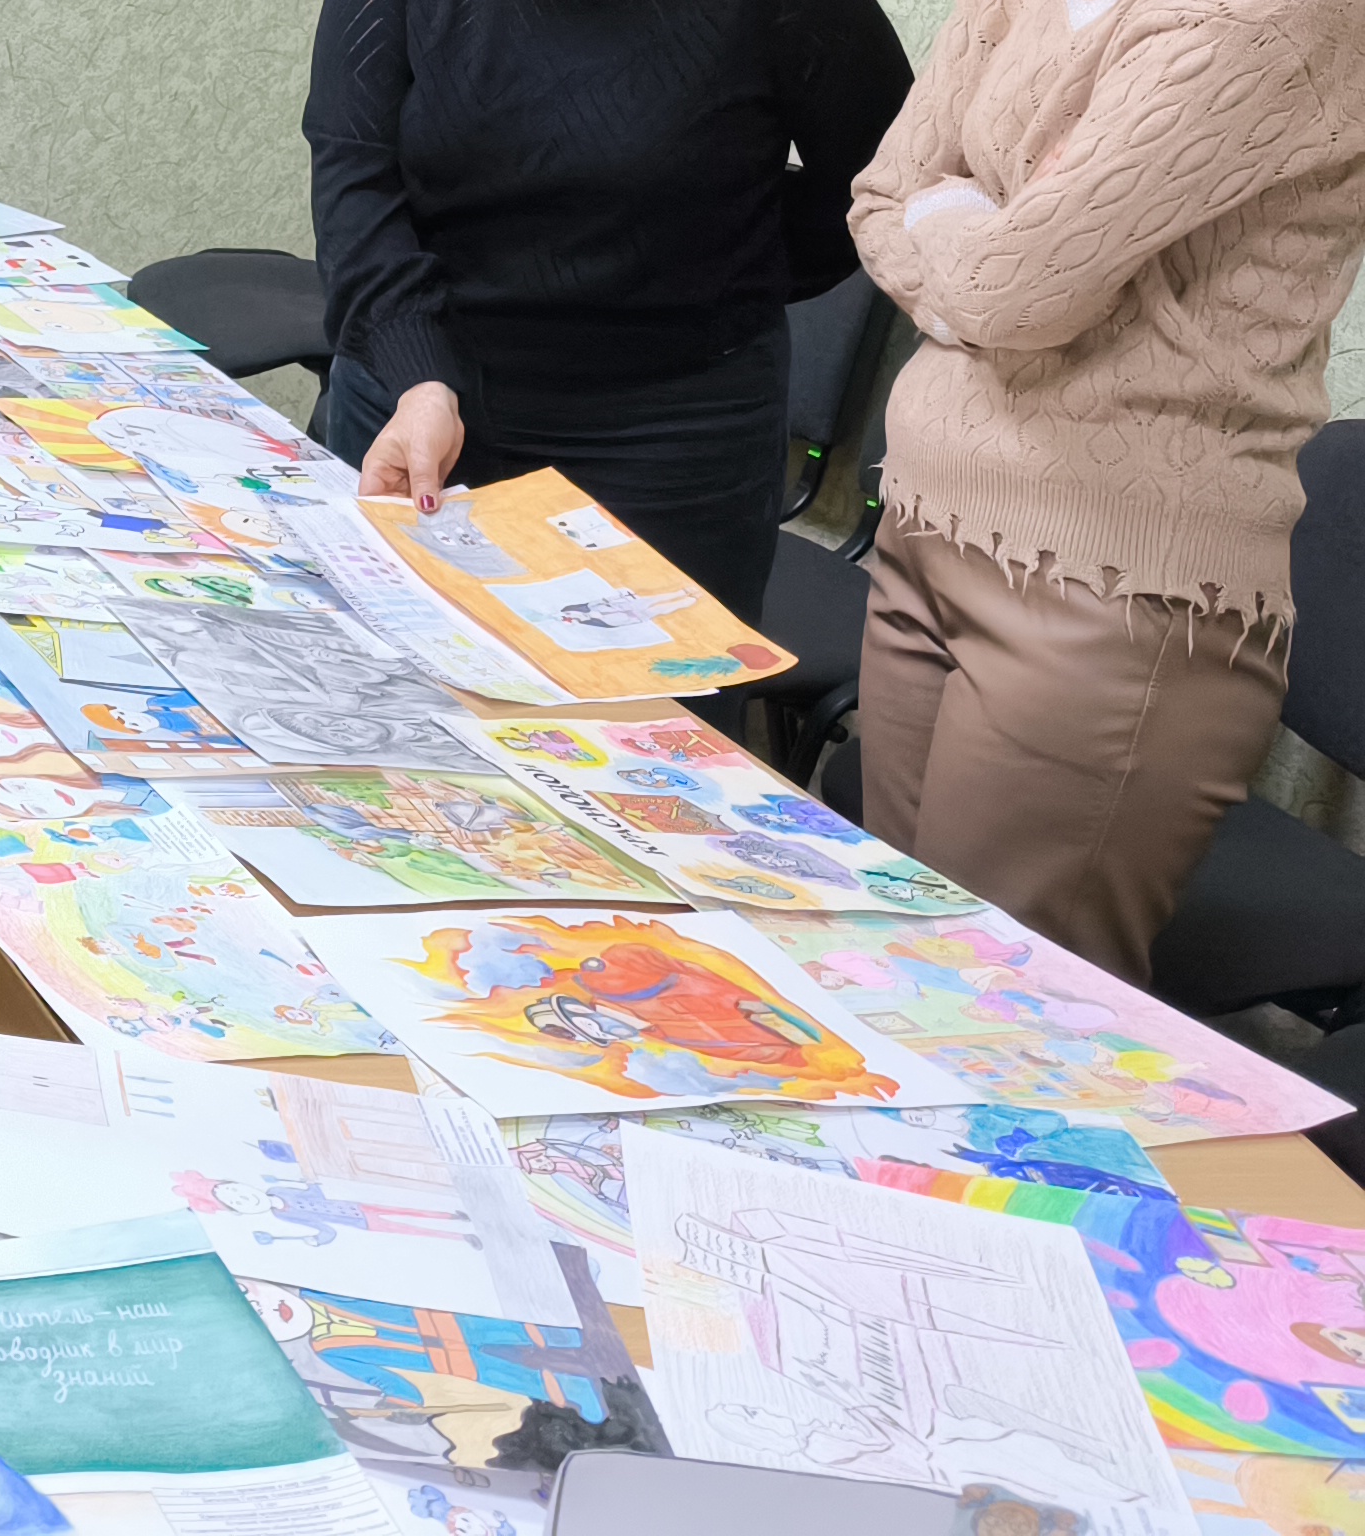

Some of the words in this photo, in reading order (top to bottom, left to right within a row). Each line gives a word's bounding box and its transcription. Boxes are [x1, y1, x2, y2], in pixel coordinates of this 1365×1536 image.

[515, 762, 671, 858] КРАСНОДОН
[119, 1299, 171, 1320] наш
[107, 1330, 124, 1358] в
[133, 1336, 184, 1370] мир
[52, 1365, 155, 1403] знаний
